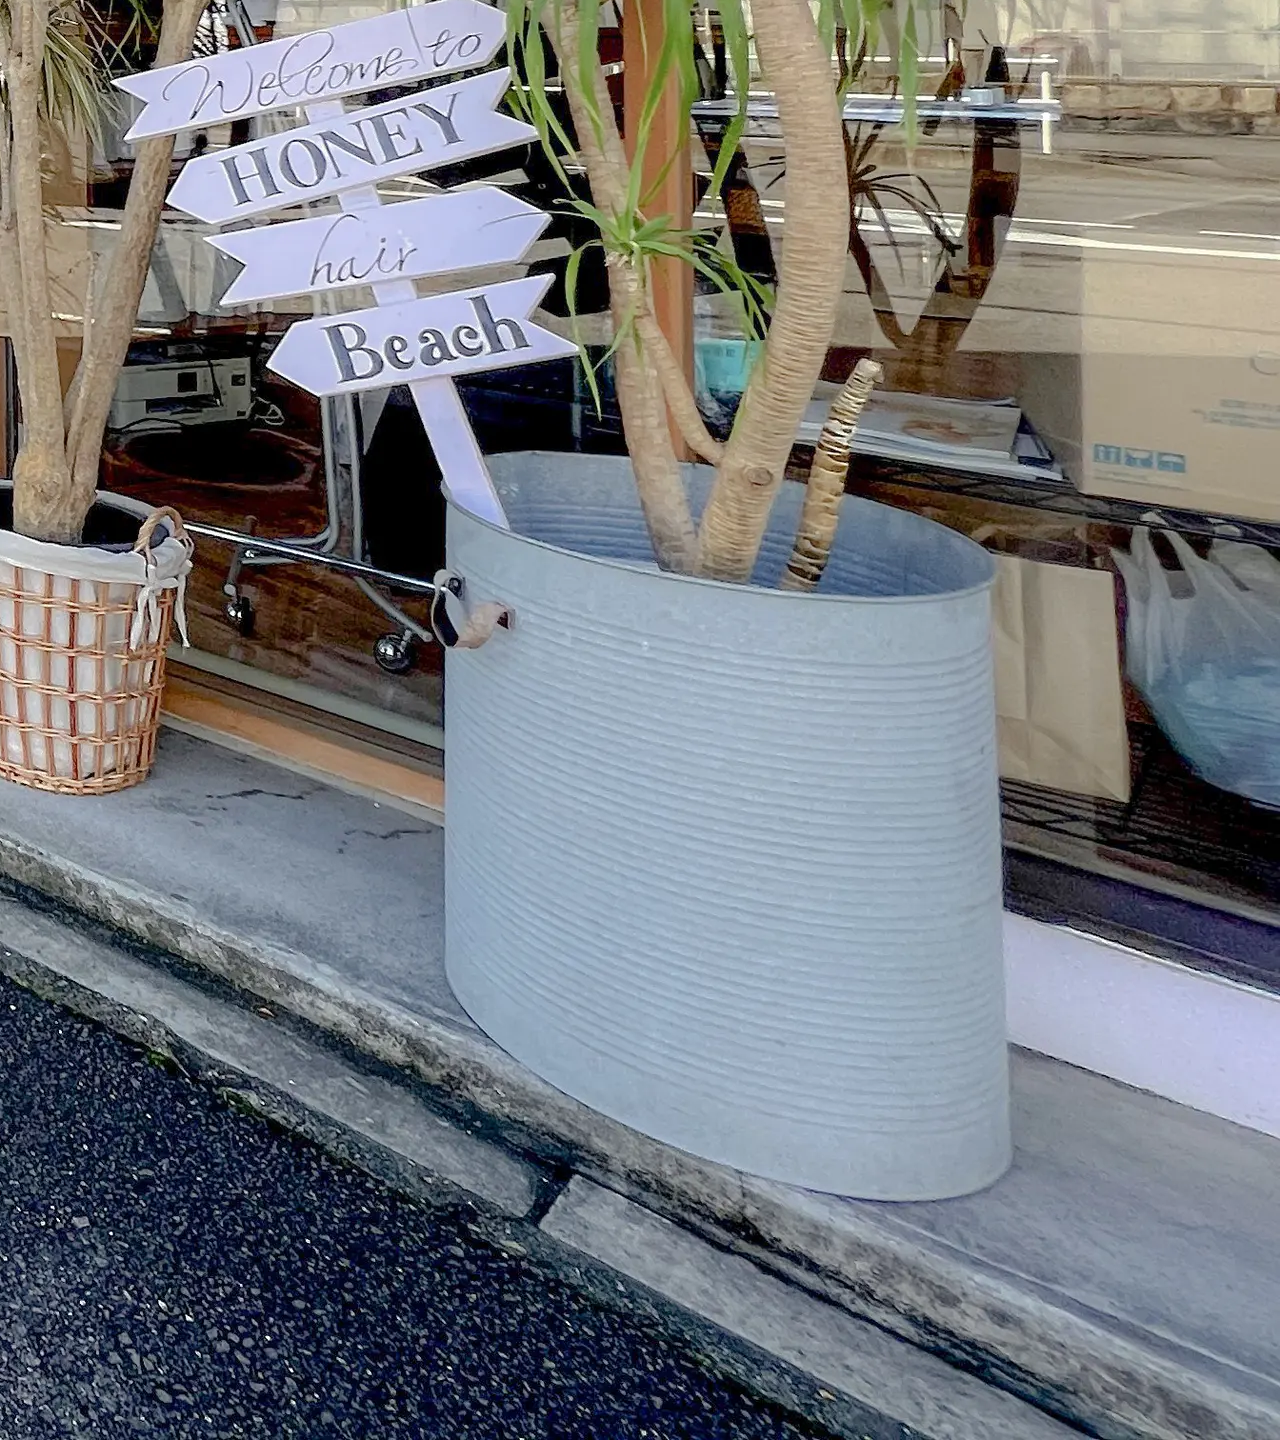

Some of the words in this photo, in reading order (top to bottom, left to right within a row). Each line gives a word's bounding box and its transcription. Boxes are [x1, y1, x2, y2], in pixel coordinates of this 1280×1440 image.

[162, 30, 420, 121] Welcome
[424, 29, 482, 70] to
[220, 90, 465, 207] HONEY
[310, 213, 420, 287] hair
[321, 294, 534, 386] Beach
